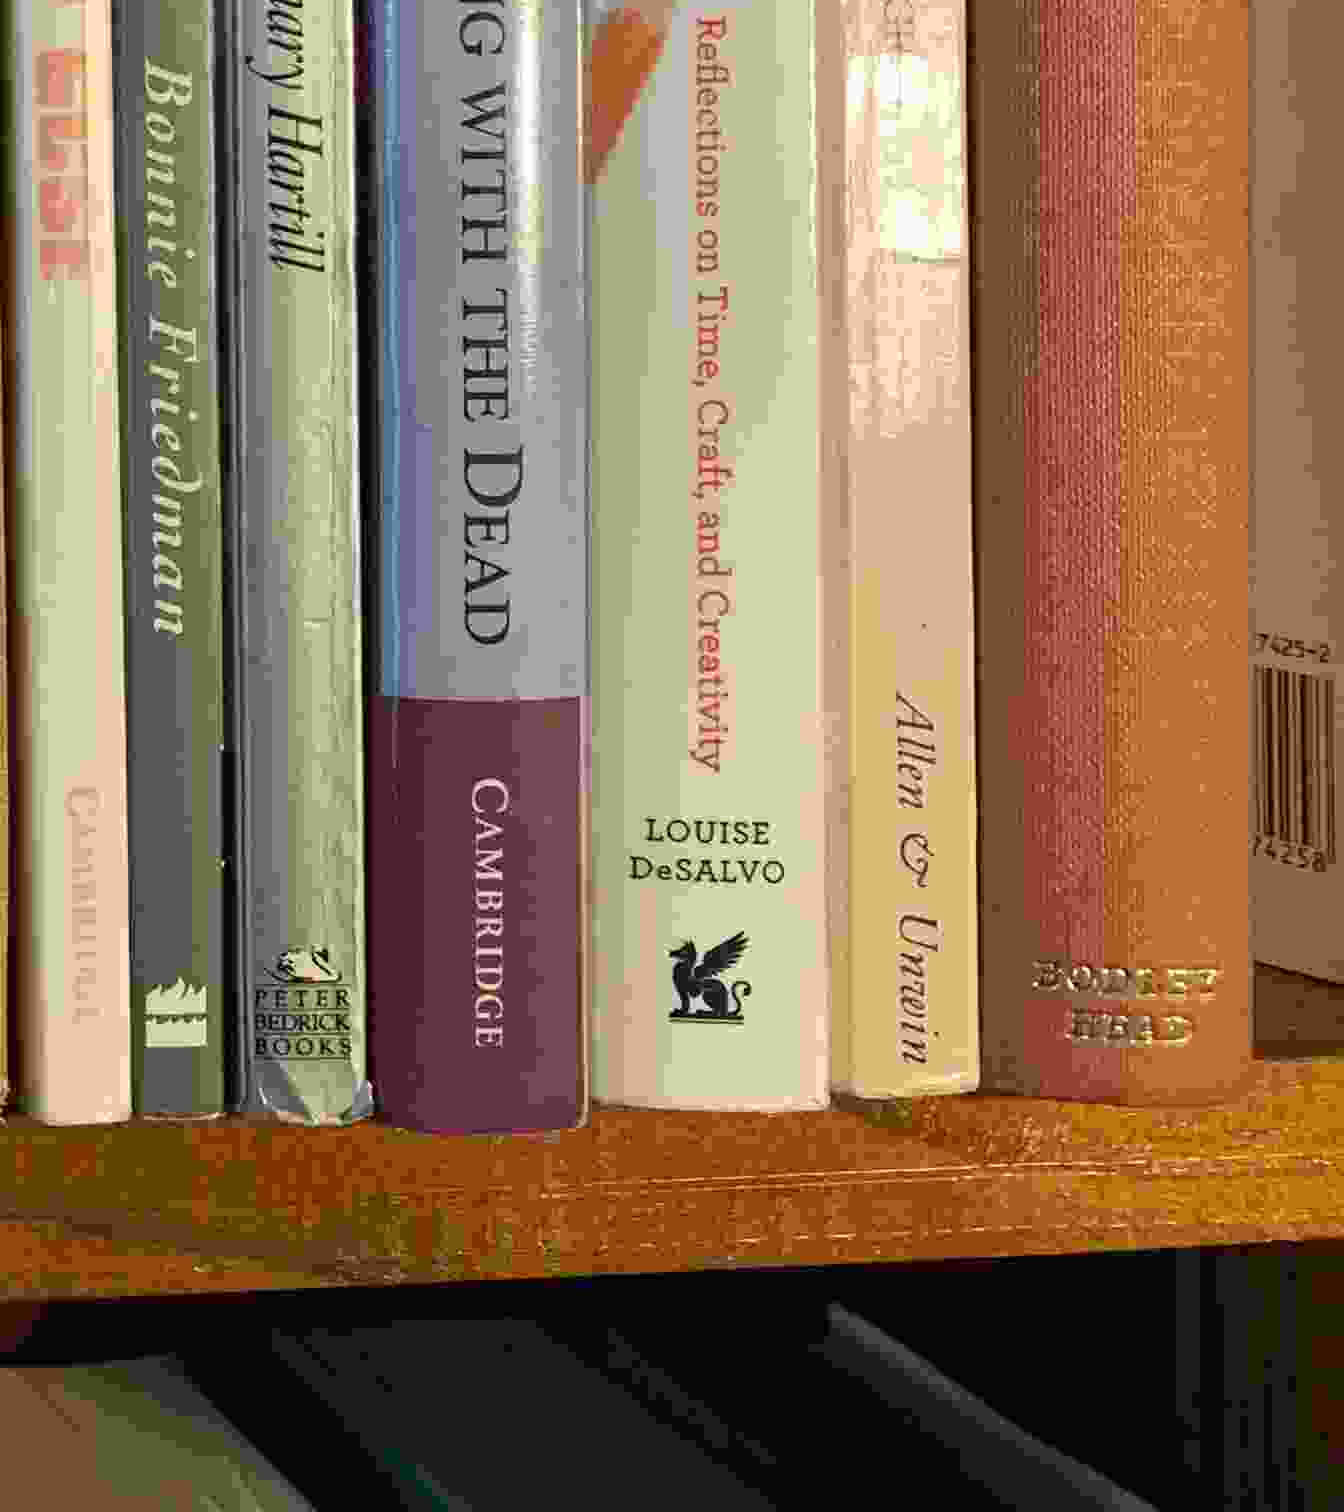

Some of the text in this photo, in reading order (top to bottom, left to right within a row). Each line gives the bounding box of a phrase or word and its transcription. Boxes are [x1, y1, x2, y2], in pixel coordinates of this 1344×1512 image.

[264, 105, 323, 271] Hartill
[458, 82, 508, 265] WITH
[142, 58, 202, 639] Bonnie Friedman
[459, 291, 509, 423] THE
[691, 17, 731, 774] Reflections on Time, Craft, and Creativity
[461, 448, 523, 646] DEAD
[471, 778, 509, 1048] CAMBRIDGE
[629, 857, 784, 884] DeSALVO
[645, 818, 770, 845] LOUISE
[896, 693, 940, 1064] Allen & Unwin
[255, 989, 349, 1007] PETER
[255, 1014, 350, 1031] BEDRICK
[255, 1037, 352, 1055] BOOKS
